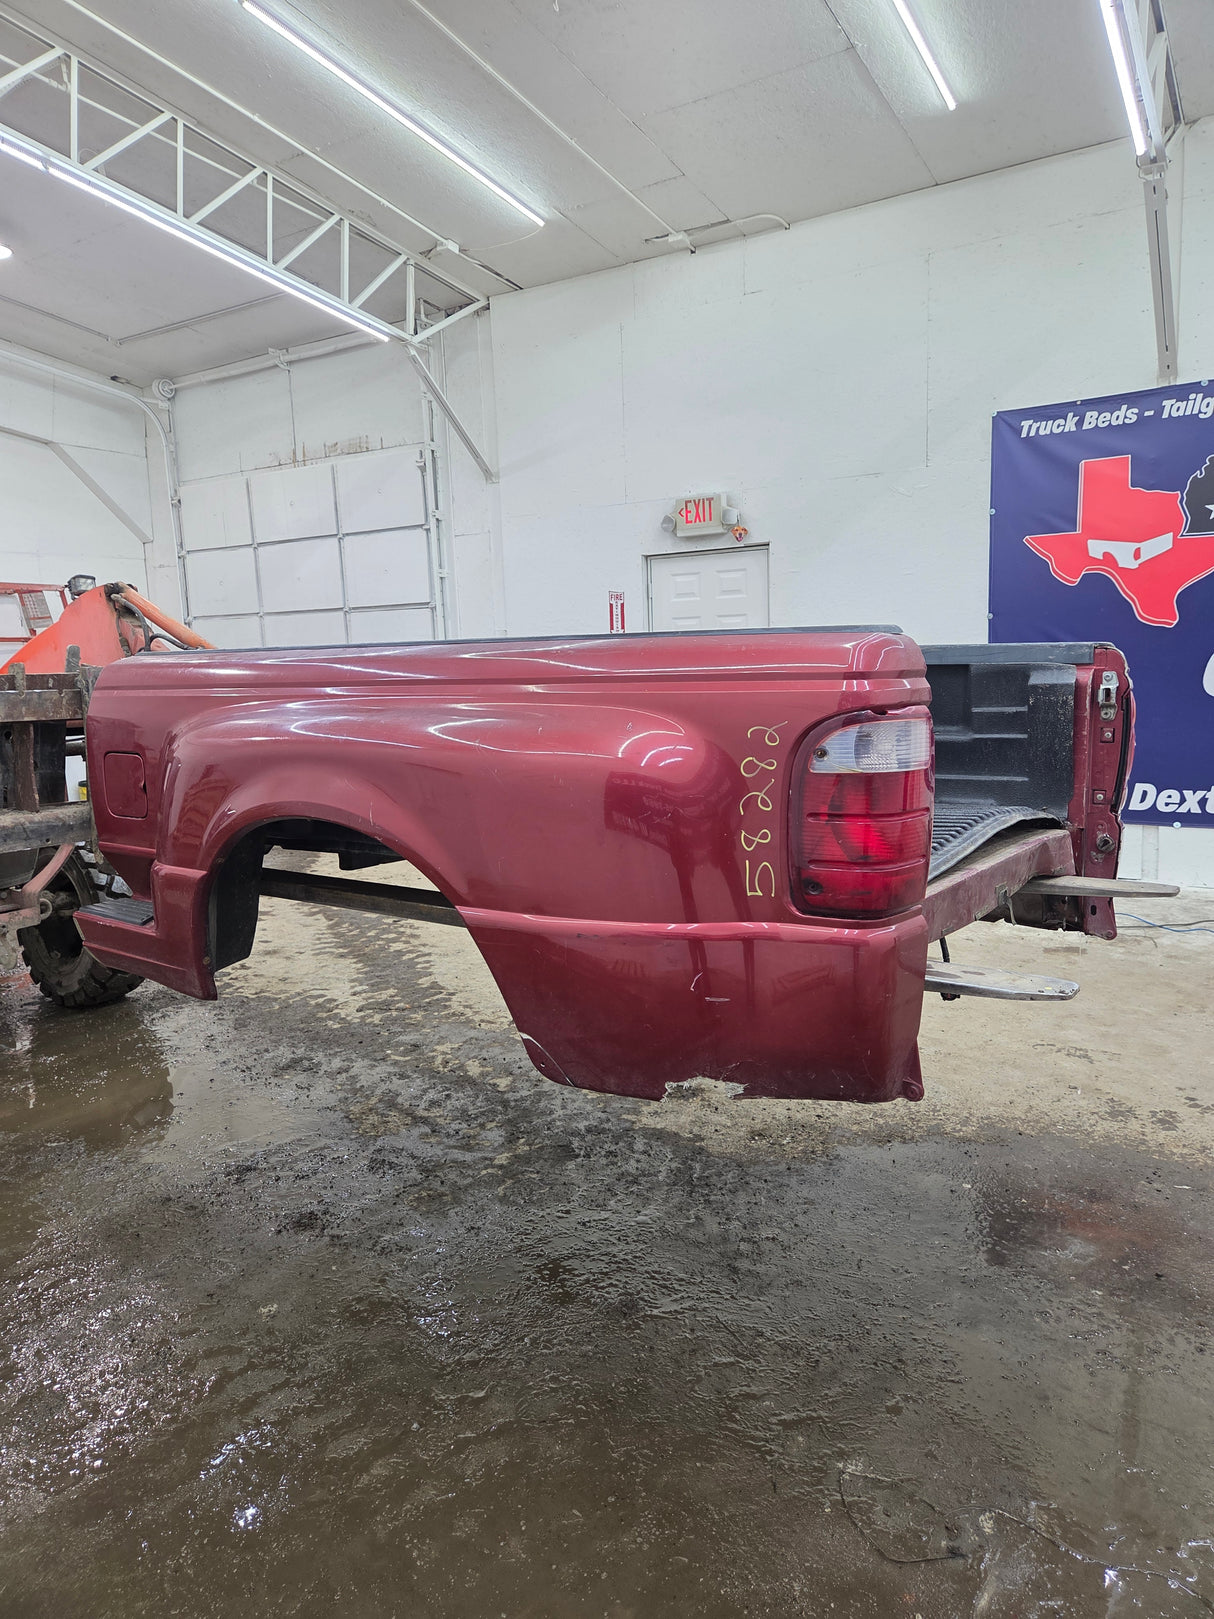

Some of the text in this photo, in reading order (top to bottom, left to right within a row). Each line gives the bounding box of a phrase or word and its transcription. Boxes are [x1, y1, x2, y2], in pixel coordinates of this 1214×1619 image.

[1020, 412, 1080, 438] Truck
[1082, 405, 1138, 430] Beds
[684, 497, 714, 524] EXIT
[610, 593, 623, 601] FIRE
[740, 720, 788, 898] 58282
